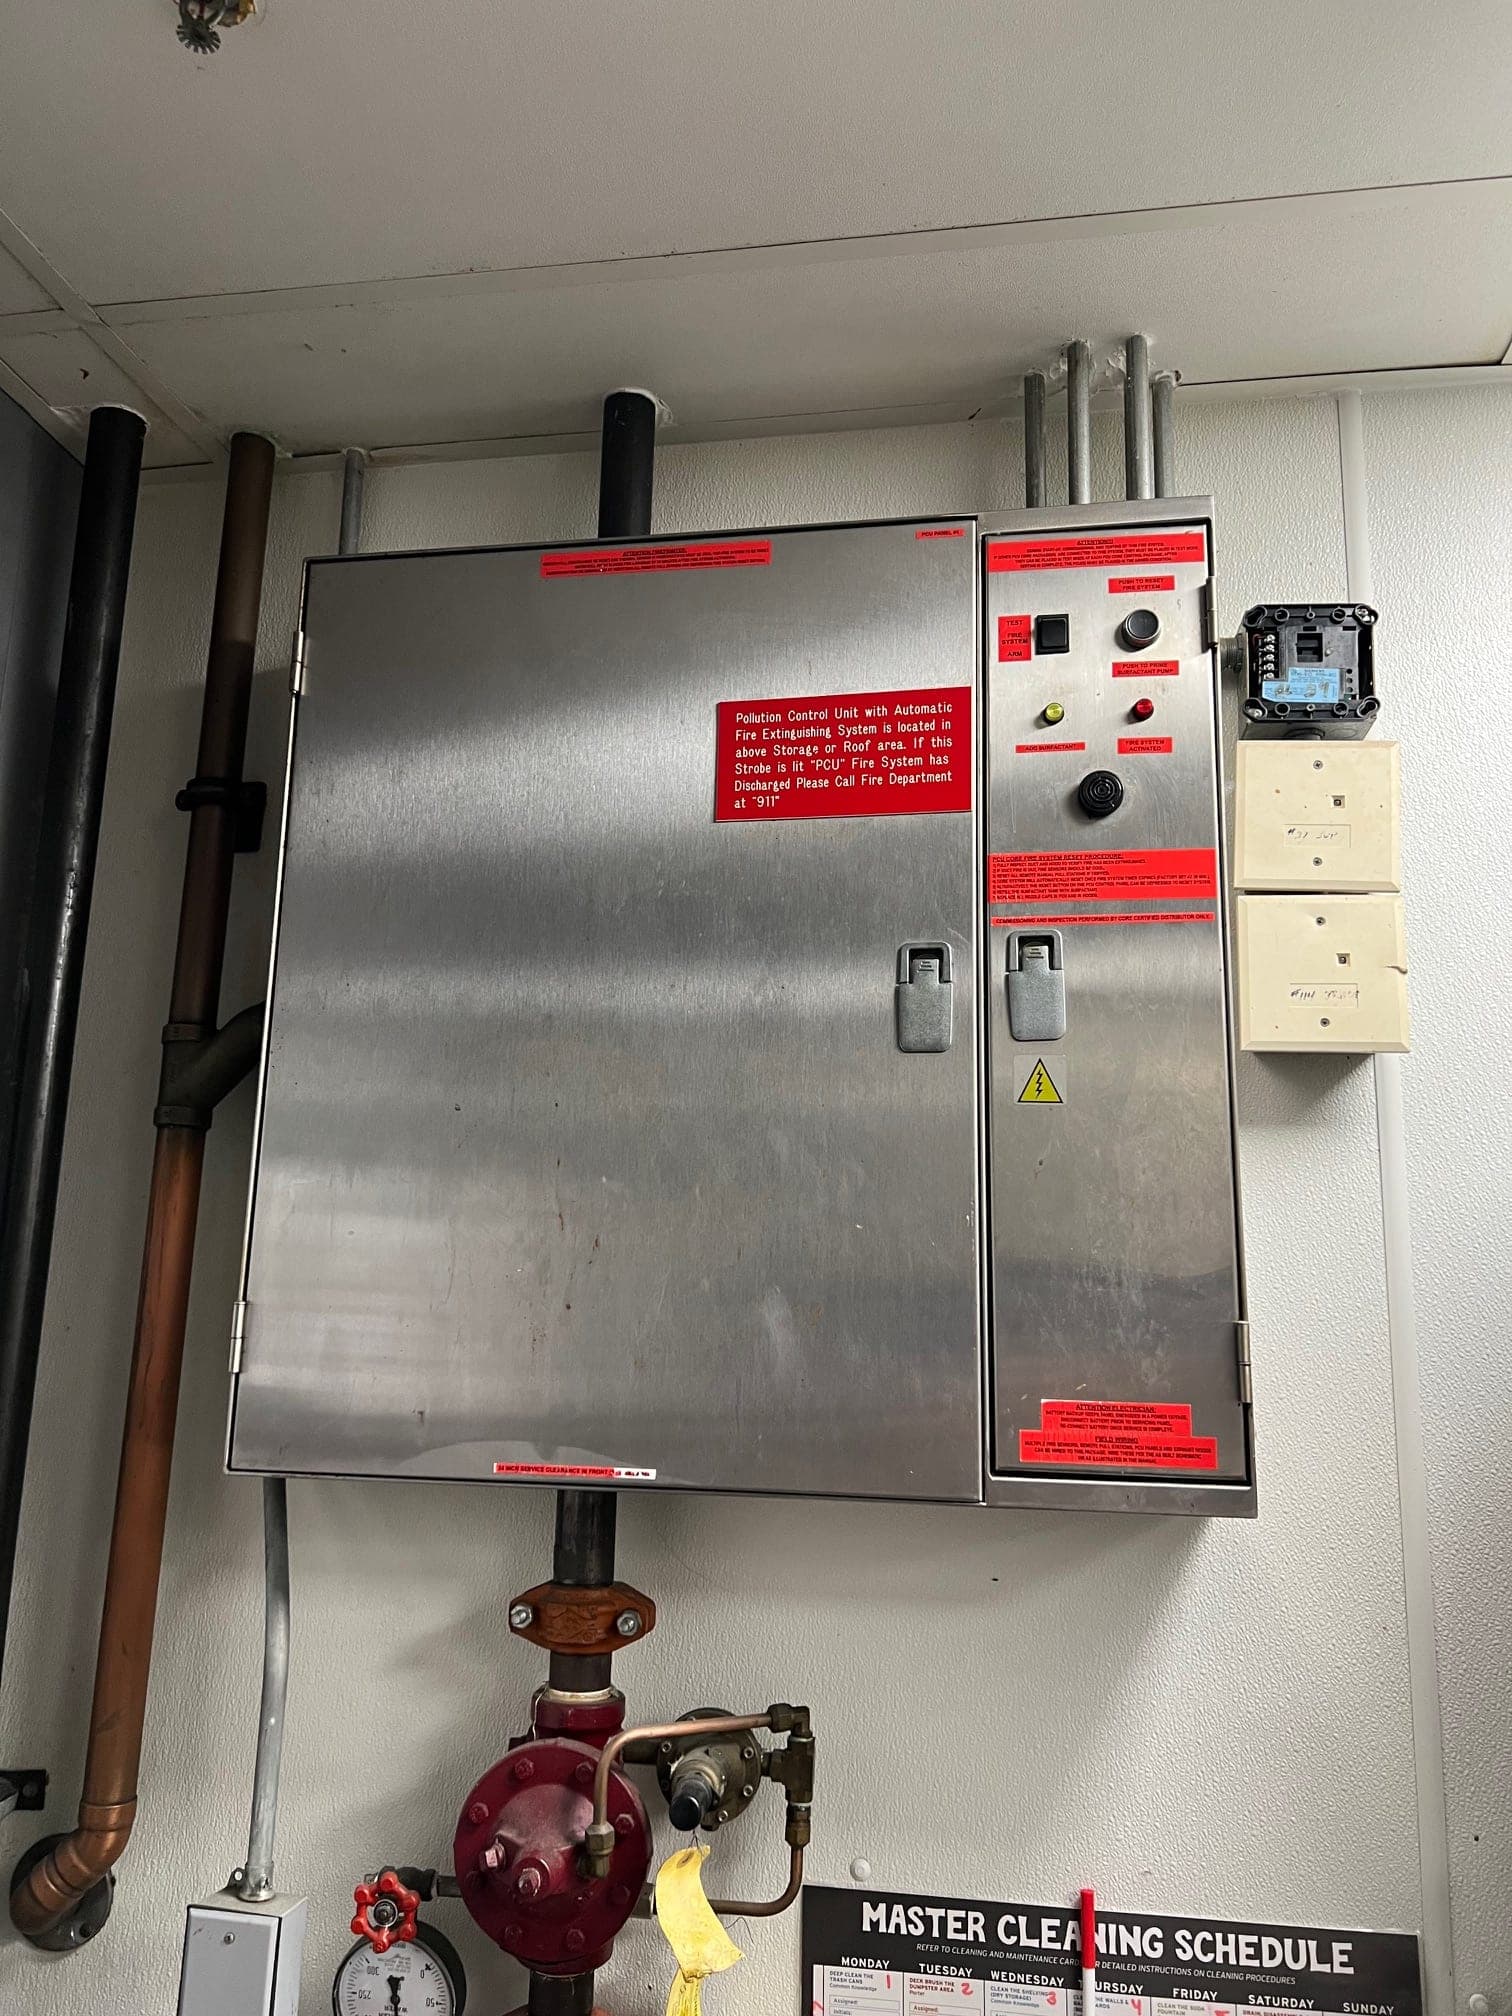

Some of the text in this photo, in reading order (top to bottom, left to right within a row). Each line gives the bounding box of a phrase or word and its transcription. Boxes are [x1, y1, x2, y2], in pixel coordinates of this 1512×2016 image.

[736, 702, 952, 723] Pollution Control Unit with Automatic
[736, 720, 950, 741] Fire Extinguishing System is located in
[736, 737, 952, 757] above Storage or Roof area. If this
[735, 763, 771, 774] Strobe
[778, 762, 786, 772] is
[793, 760, 804, 771] lit
[852, 758, 874, 769] Fire
[882, 756, 922, 769] System
[930, 755, 949, 765] has
[735, 771, 952, 792] Discharged Please Call Fire Department
[735, 798, 746, 808] at
[862, 1902, 1355, 1974] MASTER CLEANING SCHEDULE
[841, 1956, 890, 1970] MONDAY
[917, 1944, 939, 1952] REFER
[941, 1945, 950, 1953] TO
[952, 1947, 987, 1958] CLEANING
[1006, 1952, 1058, 1964] MAINTENANCE
[1060, 1957, 1082, 1966] CARD
[919, 1963, 972, 1977] TUESDAY
[991, 1970, 1064, 1986] WEDNESDAY
[1102, 1962, 1137, 1971] DETAILED
[1138, 1965, 1192, 1976] INSTRUCTIONS
[1194, 1969, 1205, 1977] ON
[1207, 1970, 1244, 1981] CLEANING
[1246, 1974, 1296, 1984] PROCEDURES
[961, 1982, 973, 1995] 2
[1173, 1988, 1217, 2000] FRIDAY
[1047, 1991, 1057, 2005] 3
[1249, 1995, 1314, 2009] SATURDAY
[1343, 2002, 1394, 2015] SUNDAY
